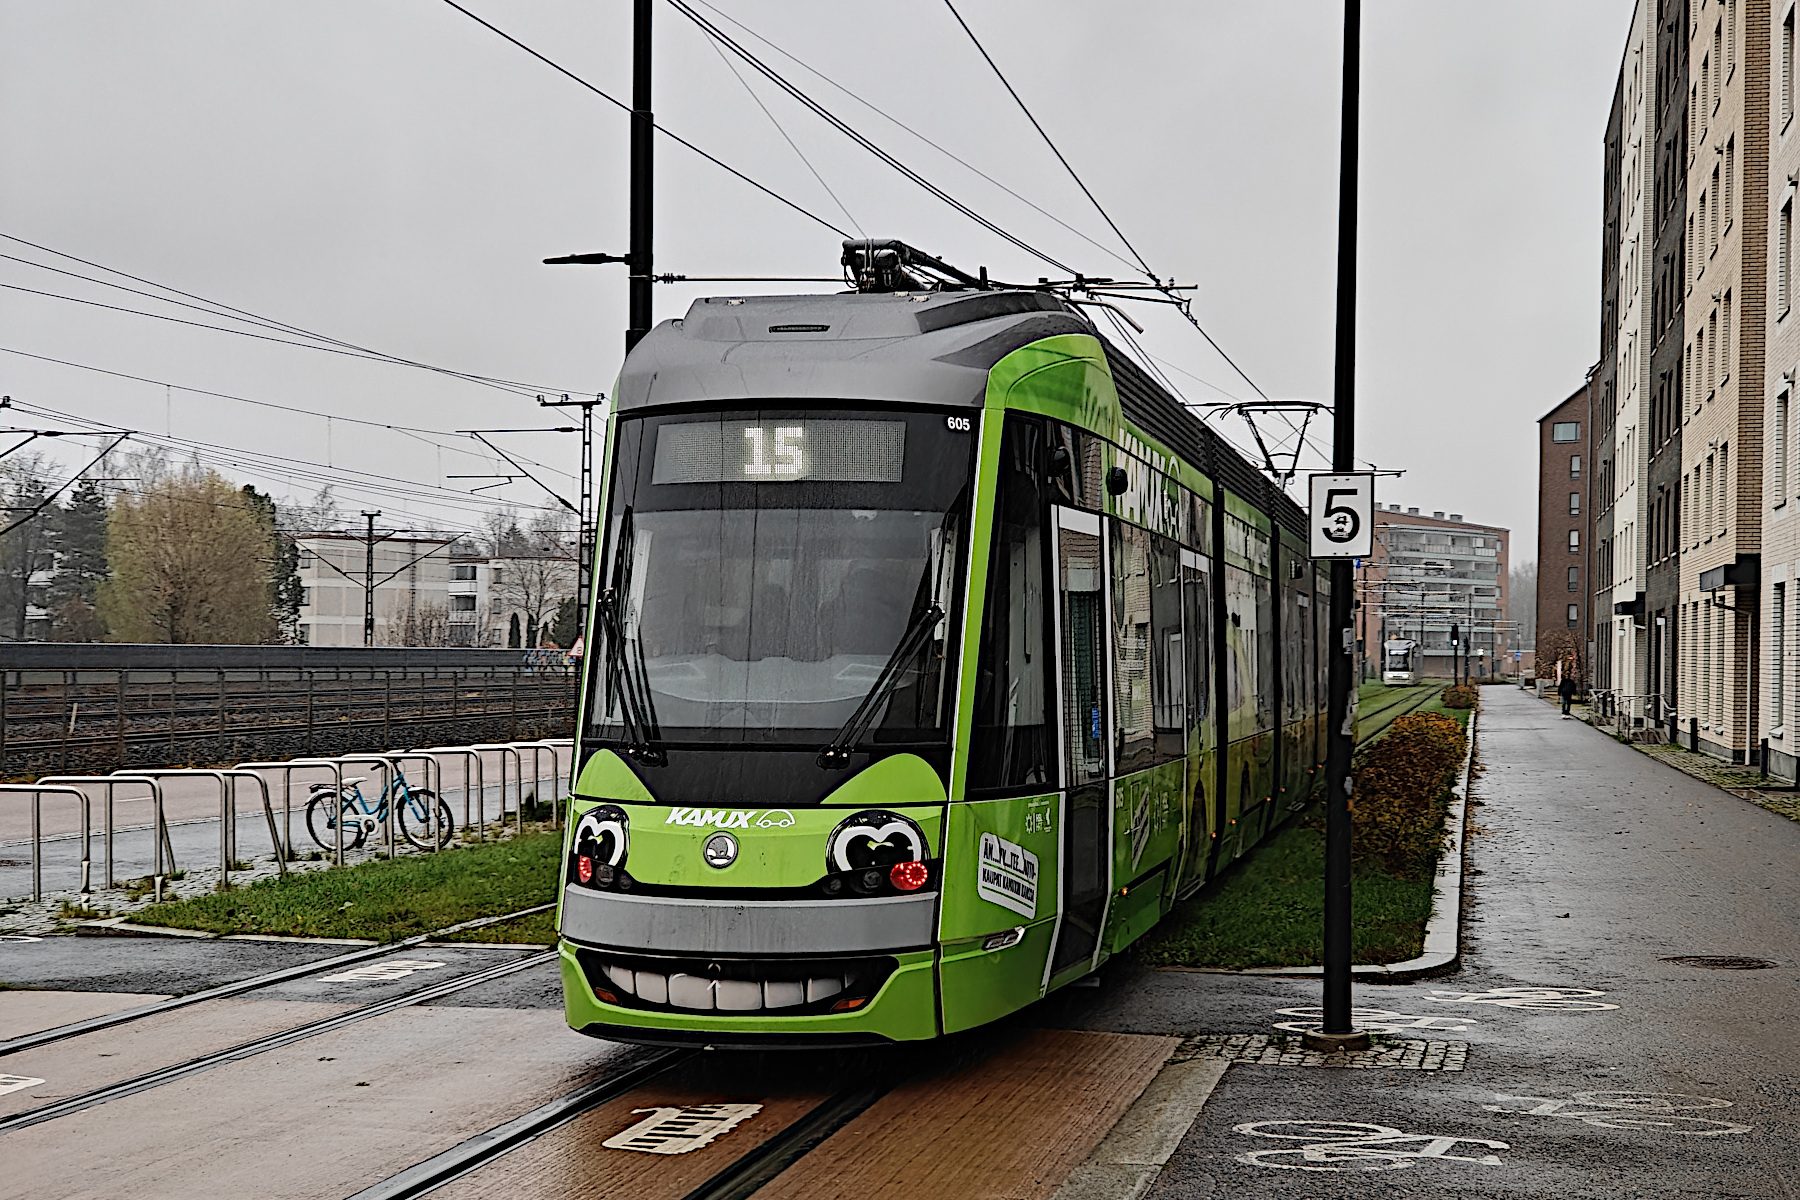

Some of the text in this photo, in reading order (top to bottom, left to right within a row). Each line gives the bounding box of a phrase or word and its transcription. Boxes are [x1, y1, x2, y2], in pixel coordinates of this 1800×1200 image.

[947, 416, 971, 431] 605
[745, 427, 803, 474] 15
[1322, 488, 1360, 543] 5
[665, 807, 757, 828] KAMUX
